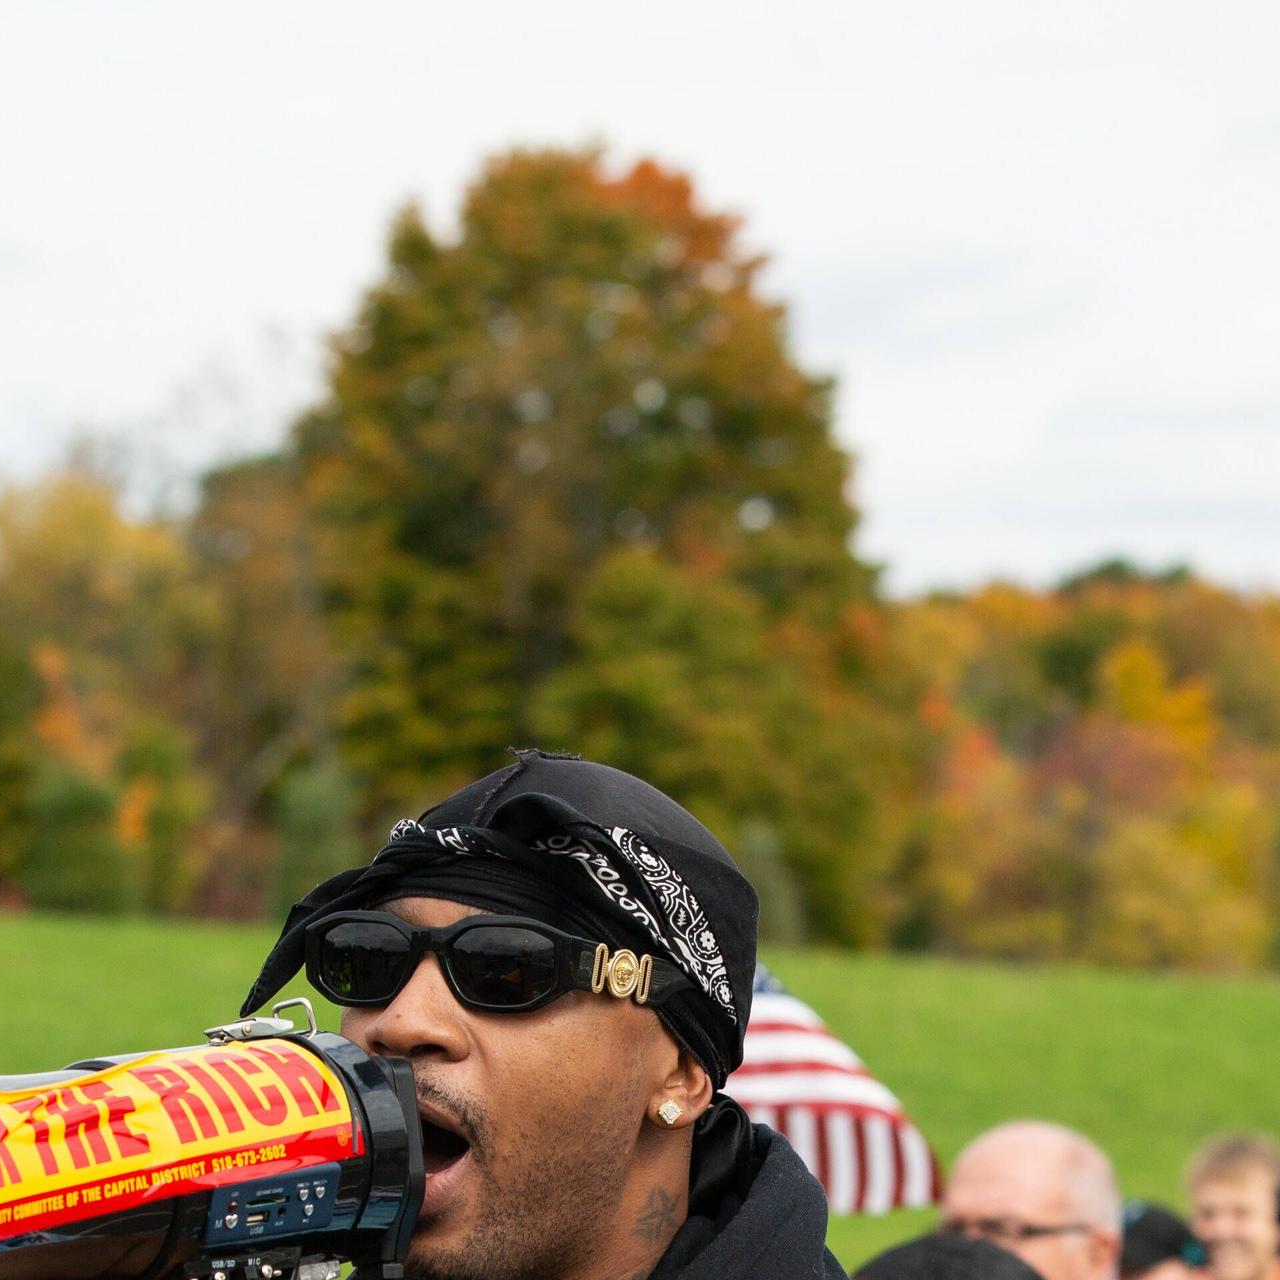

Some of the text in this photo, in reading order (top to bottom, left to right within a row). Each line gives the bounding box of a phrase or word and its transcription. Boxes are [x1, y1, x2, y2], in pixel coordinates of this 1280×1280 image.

[8, 1080, 151, 1177] THE
[128, 1044, 341, 1144] RICH
[13, 1194, 65, 1221] COMMITTEE
[66, 1191, 80, 1208] OF
[81, 1185, 102, 1204] THE
[104, 1177, 149, 1199] CAPITAL
[151, 1161, 207, 1187] DISTRICT
[211, 1143, 288, 1173] 518-673-2602
[211, 1257, 262, 1269] USB/SD MIC
